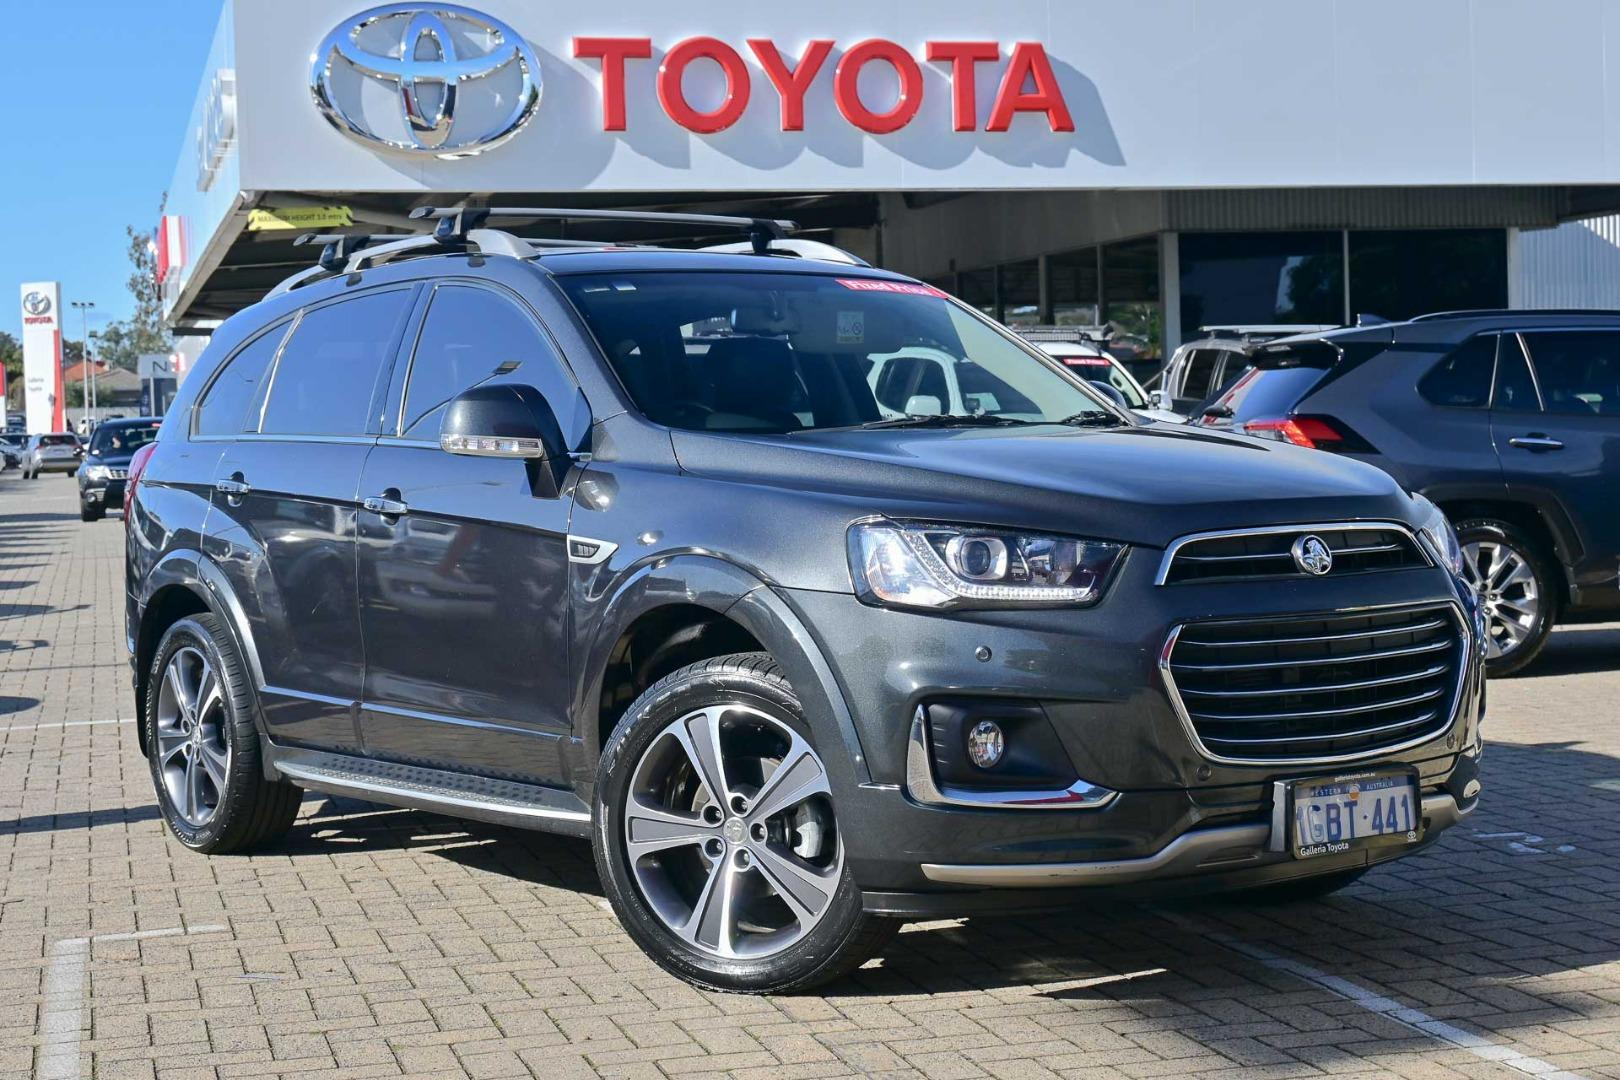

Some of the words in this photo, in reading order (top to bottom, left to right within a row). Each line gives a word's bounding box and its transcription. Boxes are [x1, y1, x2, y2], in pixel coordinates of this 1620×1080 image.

[572, 36, 1075, 134] TOYOTA
[25, 316, 53, 324] TOYOTA
[1311, 787, 1341, 797] WESTERN
[1366, 780, 1393, 791] AUSTRALIA
[1300, 845, 1327, 856] Galleria
[1327, 842, 1349, 854] Toyota
